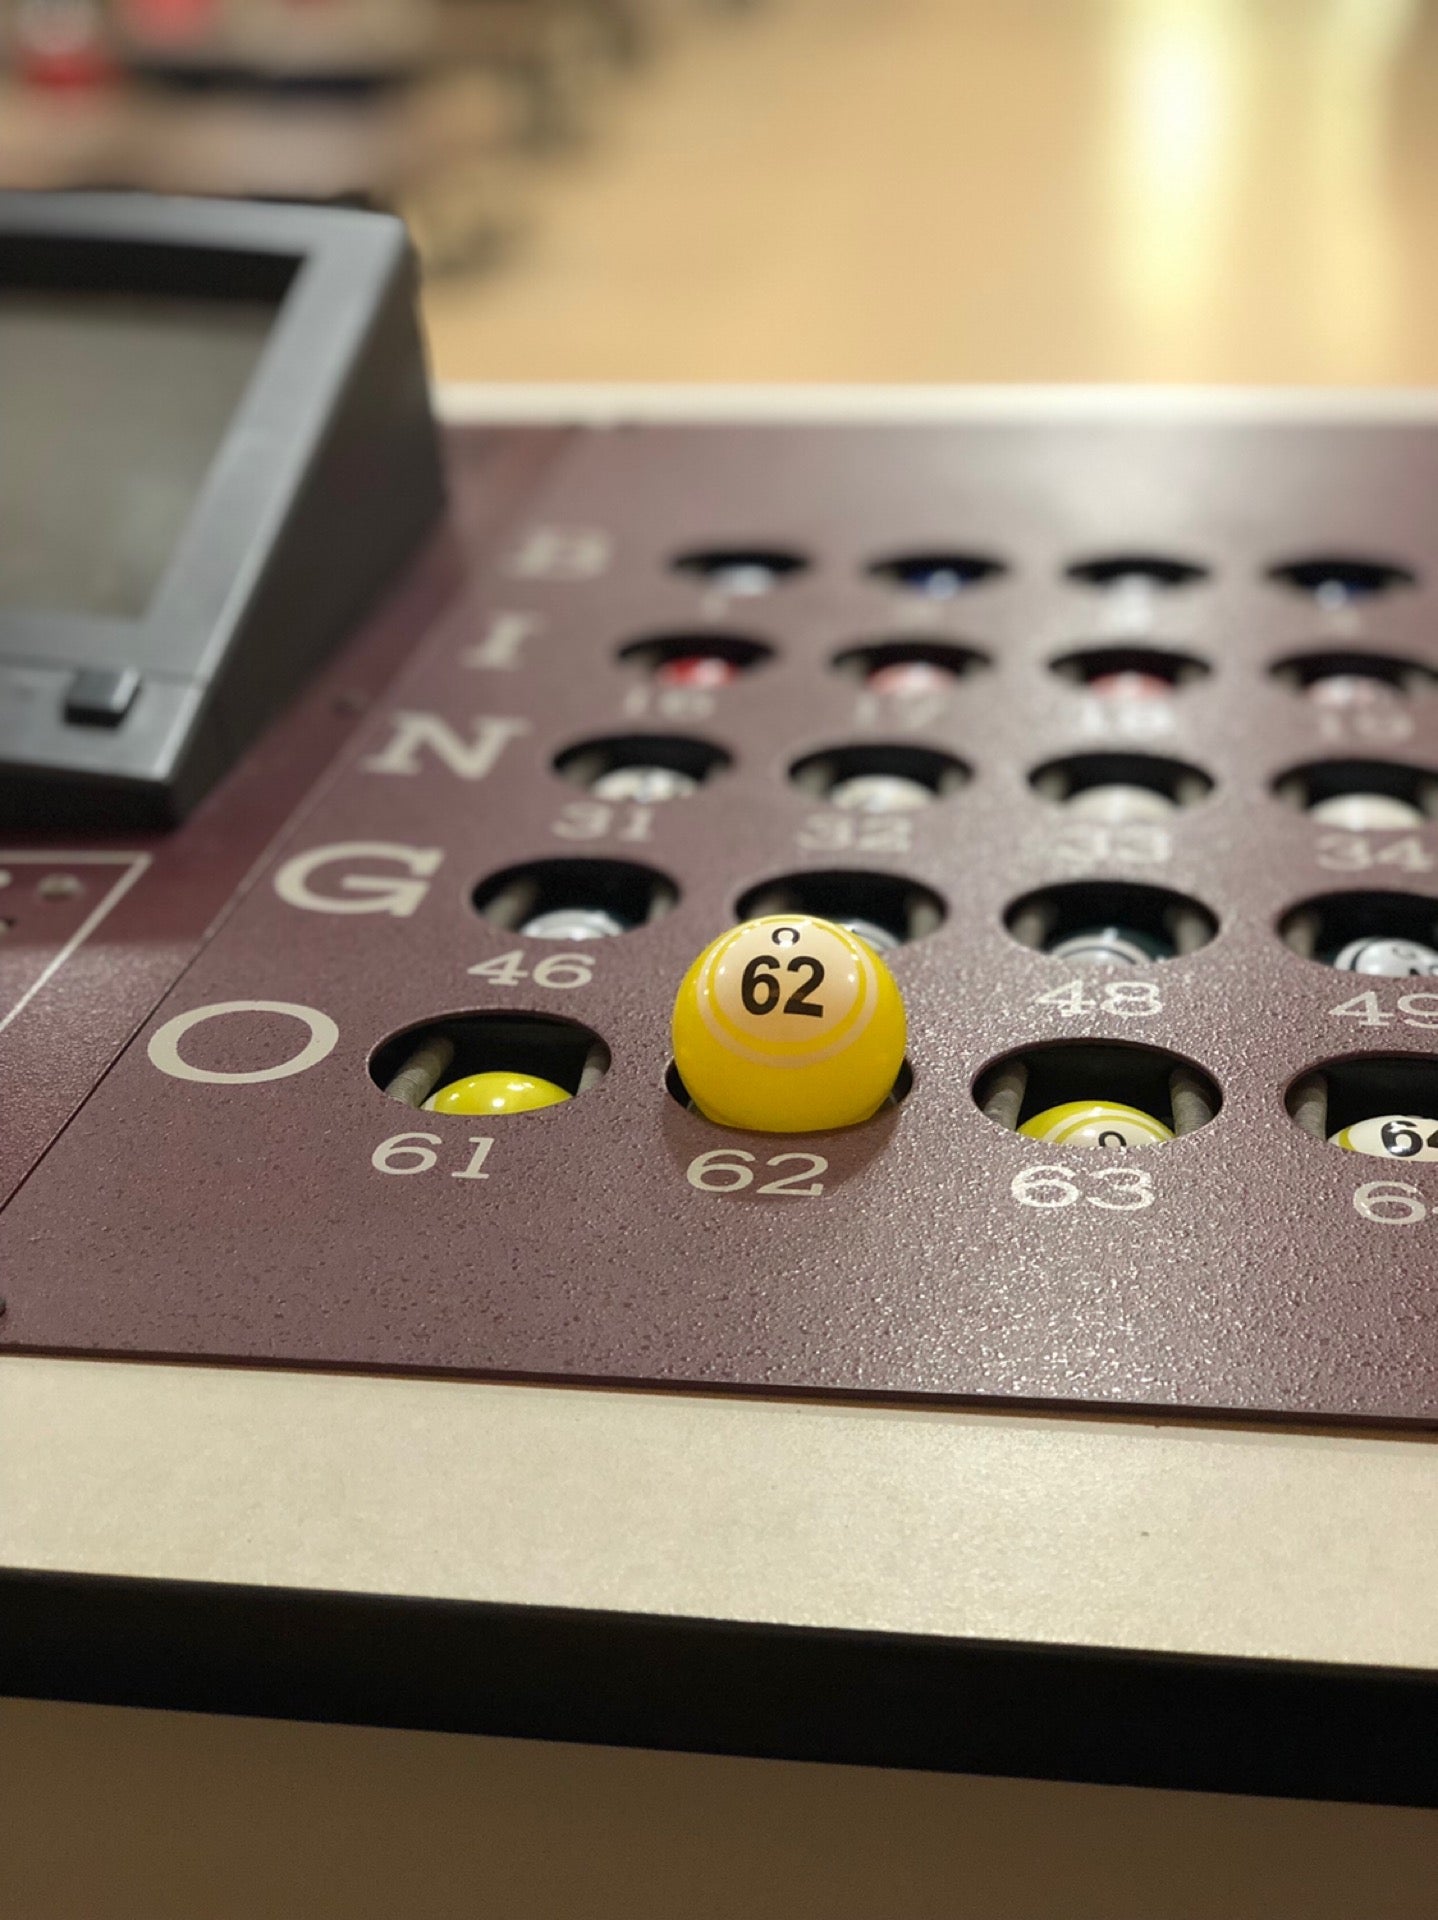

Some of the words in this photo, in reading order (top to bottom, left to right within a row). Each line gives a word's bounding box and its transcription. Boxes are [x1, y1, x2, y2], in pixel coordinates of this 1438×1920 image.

[465, 614, 541, 668] I
[365, 713, 528, 778] N
[553, 803, 653, 841] 31
[798, 814, 910, 851] 32
[1316, 834, 1434, 873] 34
[274, 842, 442, 916] G
[466, 951, 596, 990] 46
[740, 955, 826, 1018] 62
[1034, 979, 1164, 1017] 48
[1328, 991, 1438, 1029] 49
[148, 1001, 339, 1084] O
[370, 1132, 496, 1180] 61
[1381, 1120, 1438, 1158] 6
[686, 1149, 829, 1198] 62
[1010, 1165, 1155, 1211] 63
[1353, 1181, 1438, 1225] 6
